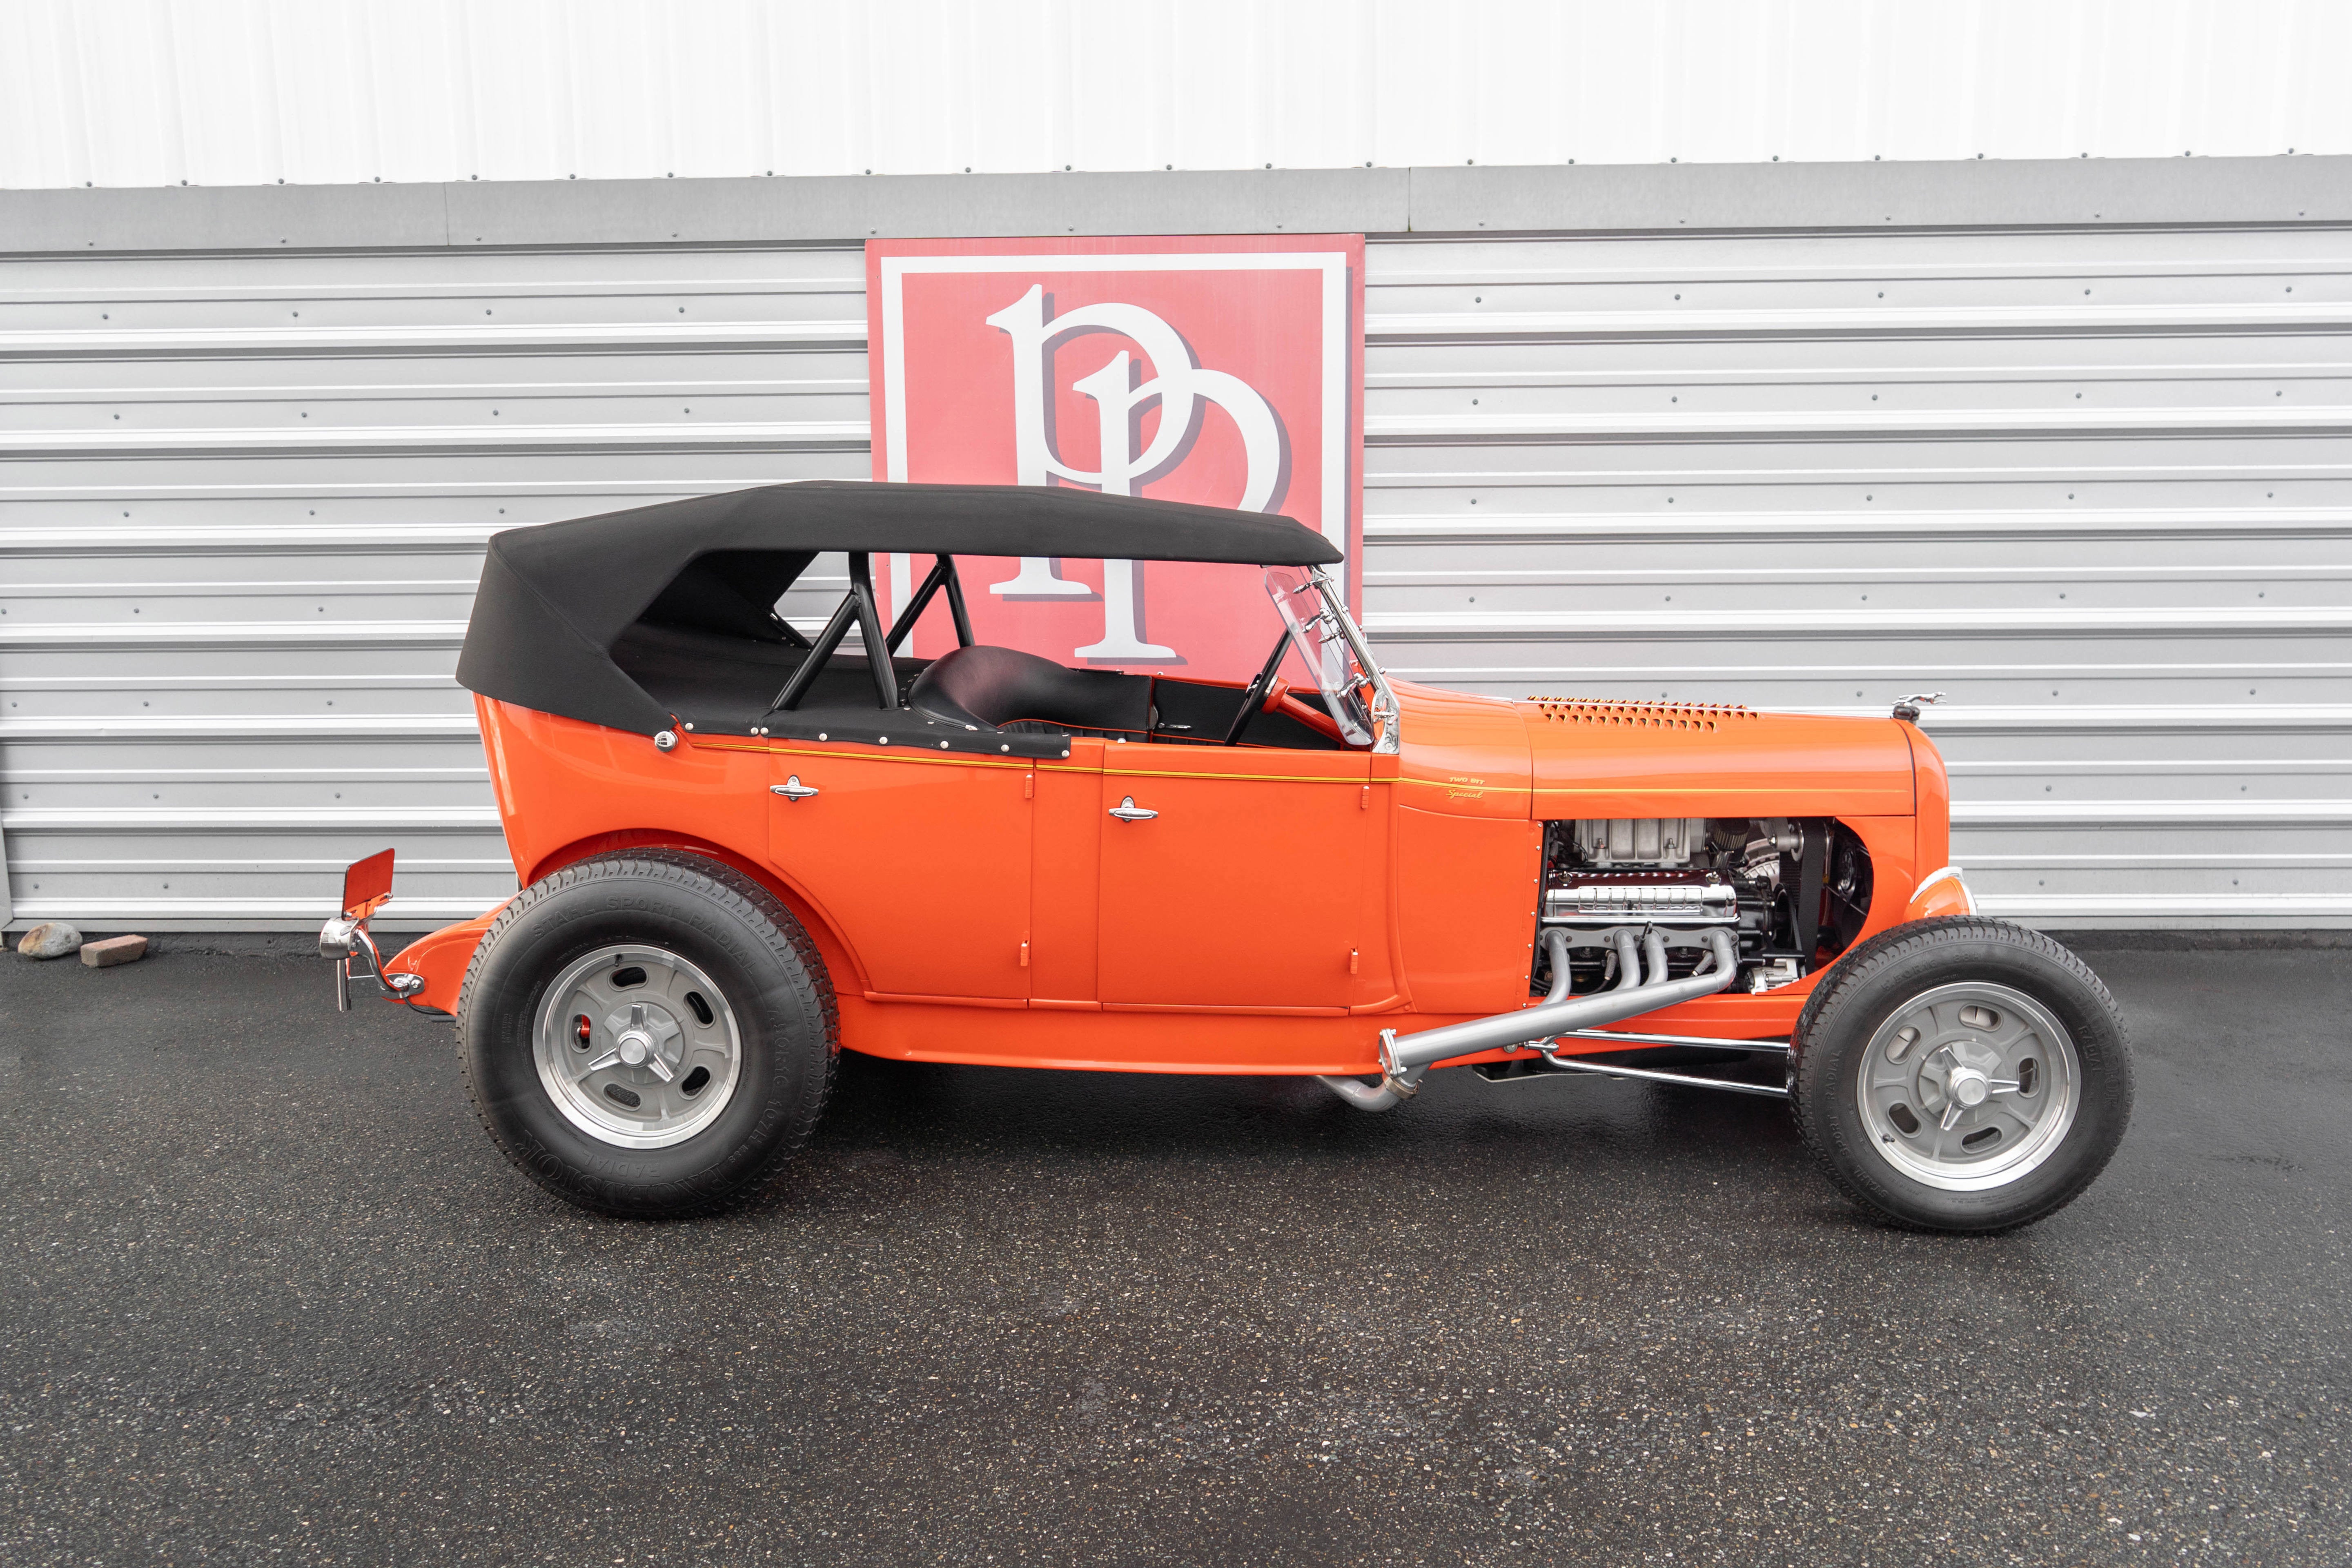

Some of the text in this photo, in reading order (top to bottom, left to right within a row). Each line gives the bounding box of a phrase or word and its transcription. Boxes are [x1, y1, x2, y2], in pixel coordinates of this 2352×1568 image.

[1446, 789, 1483, 799] Special
[532, 895, 756, 977] STAHL SPORT RADIAL
[1825, 1050, 1842, 1101] RADIAL
[514, 1129, 734, 1208] EXCELSIOR
